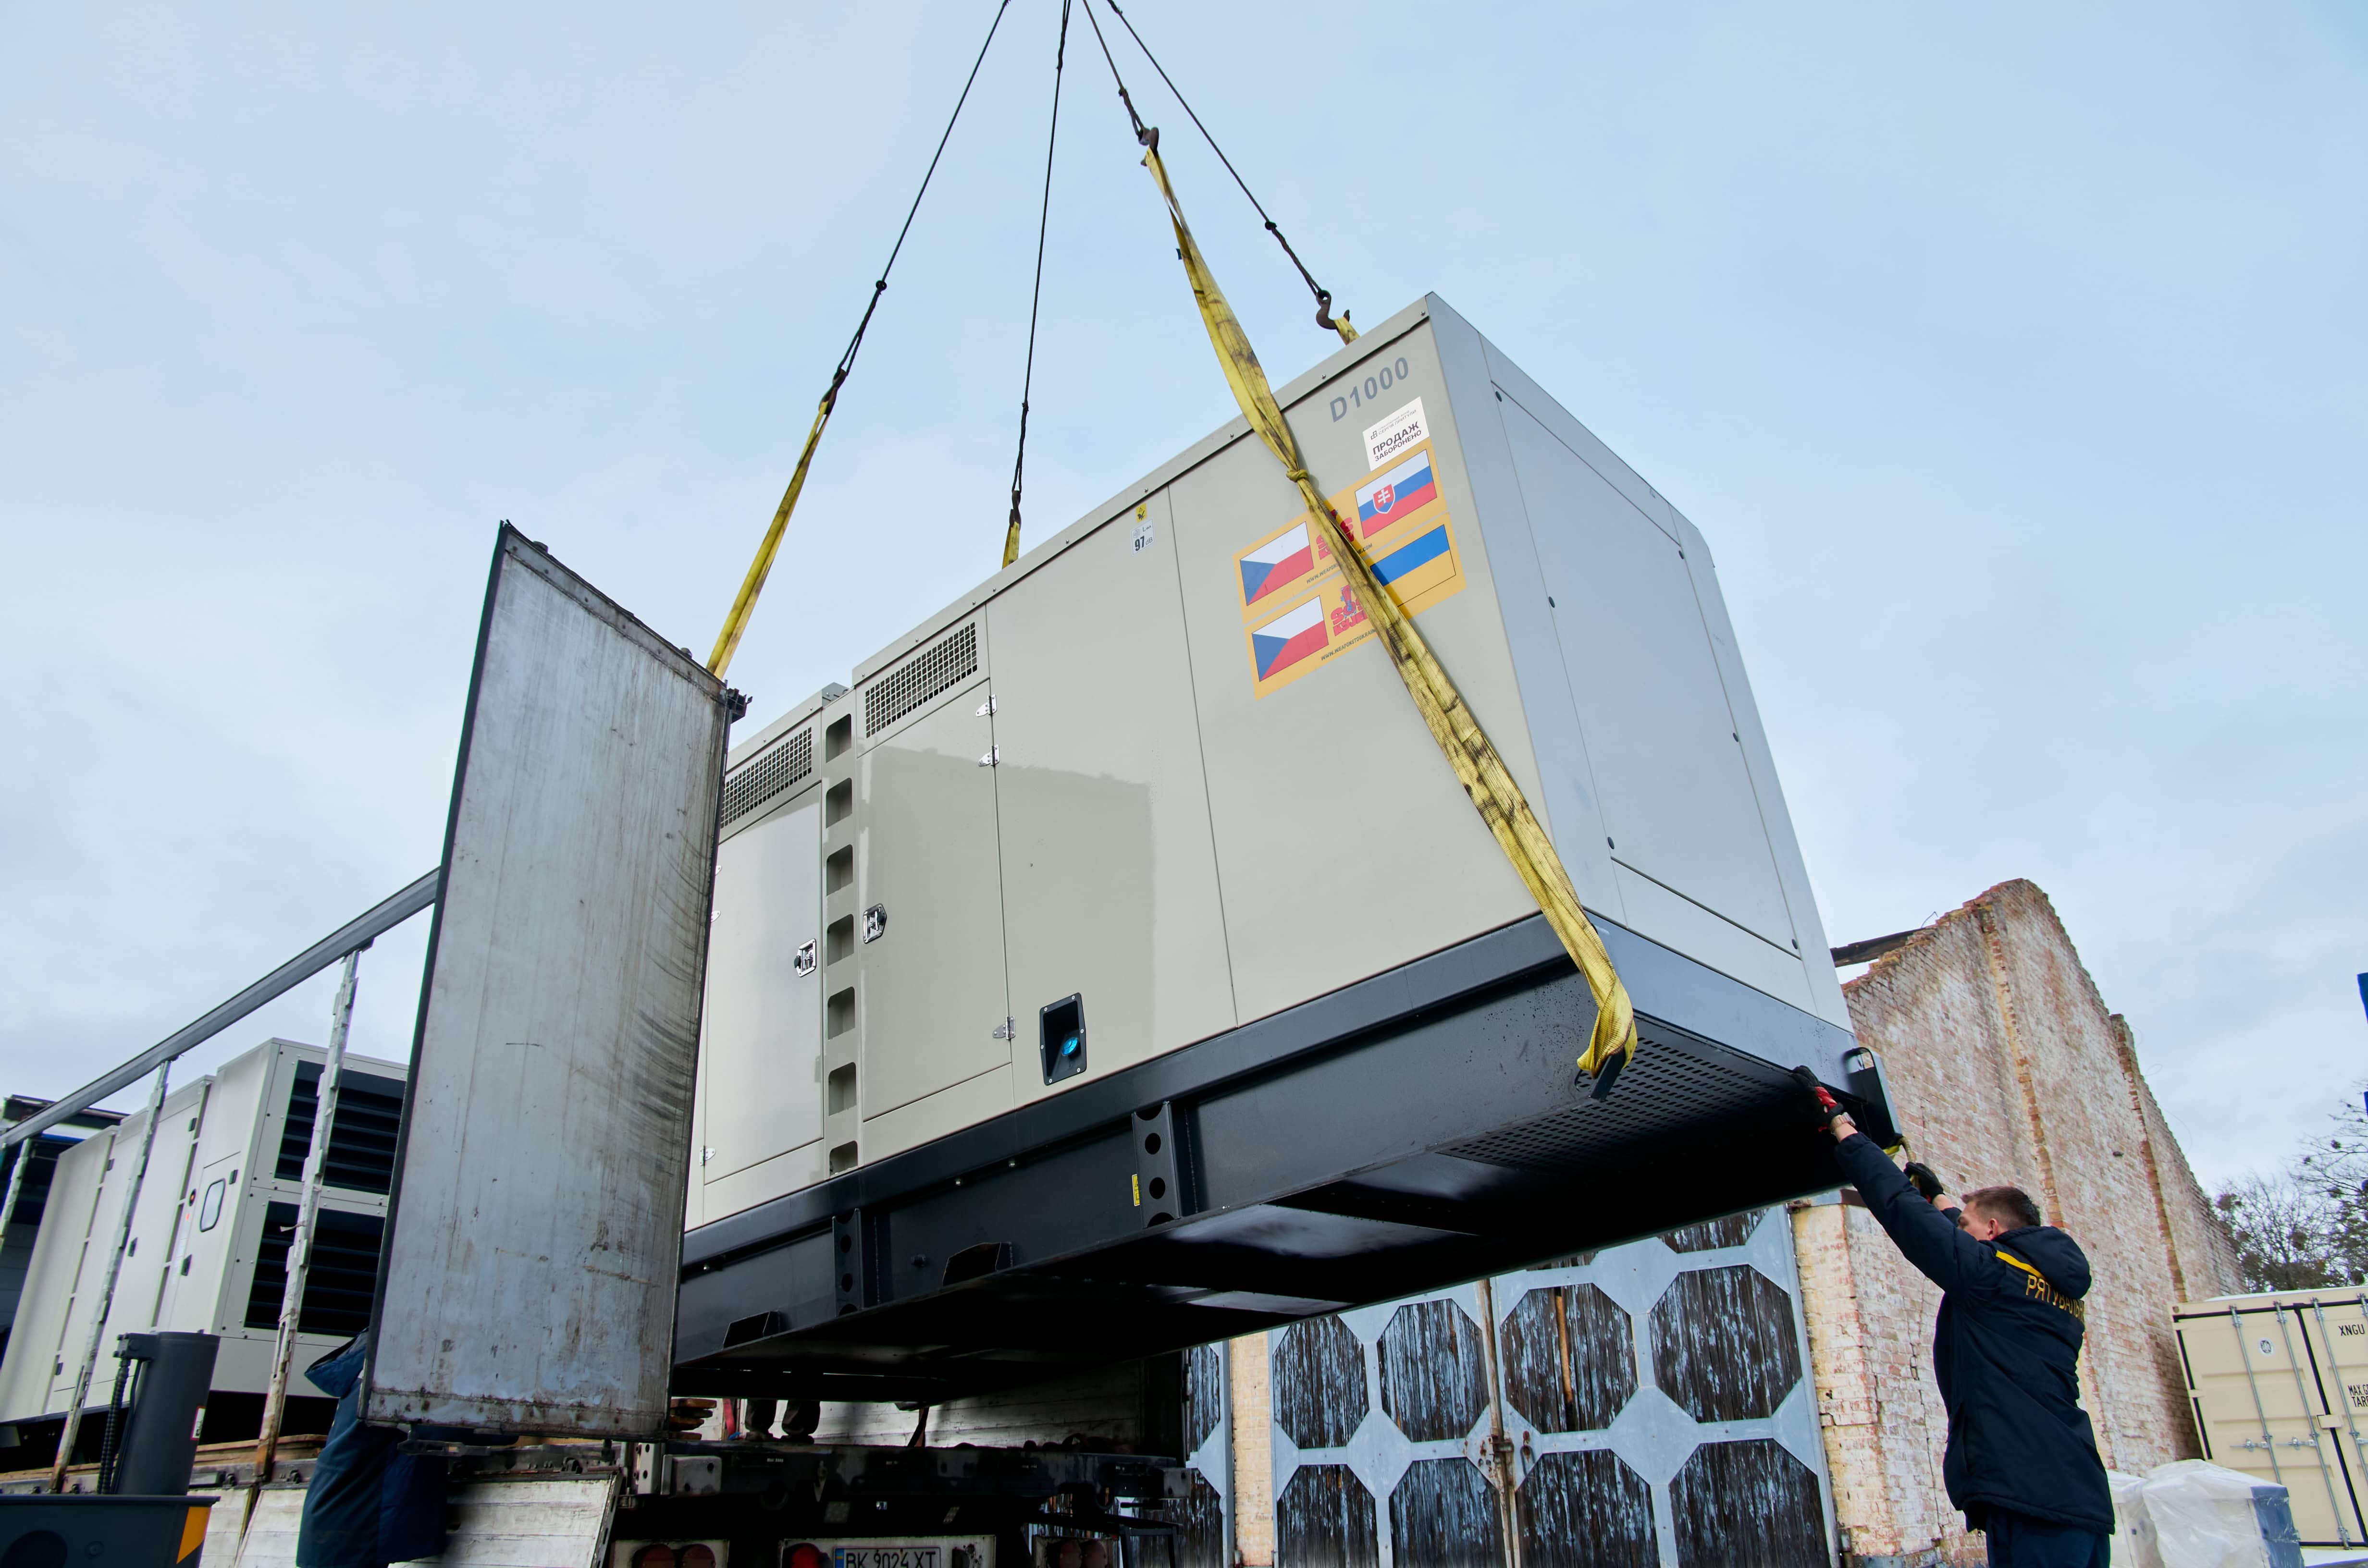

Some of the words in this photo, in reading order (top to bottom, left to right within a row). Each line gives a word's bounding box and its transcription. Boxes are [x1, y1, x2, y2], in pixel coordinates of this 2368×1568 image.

[1330, 357, 1408, 423] D1000
[1372, 421, 1419, 455] ПРОДАЖ
[1374, 430, 1421, 462] ЗАБОРОНЕНО
[1135, 535, 1145, 551] 97
[1146, 537, 1153, 545] dB
[2338, 1324, 2365, 1336] XNGU
[874, 1552, 908, 1568] 9024
[914, 1551, 936, 1568] XT
